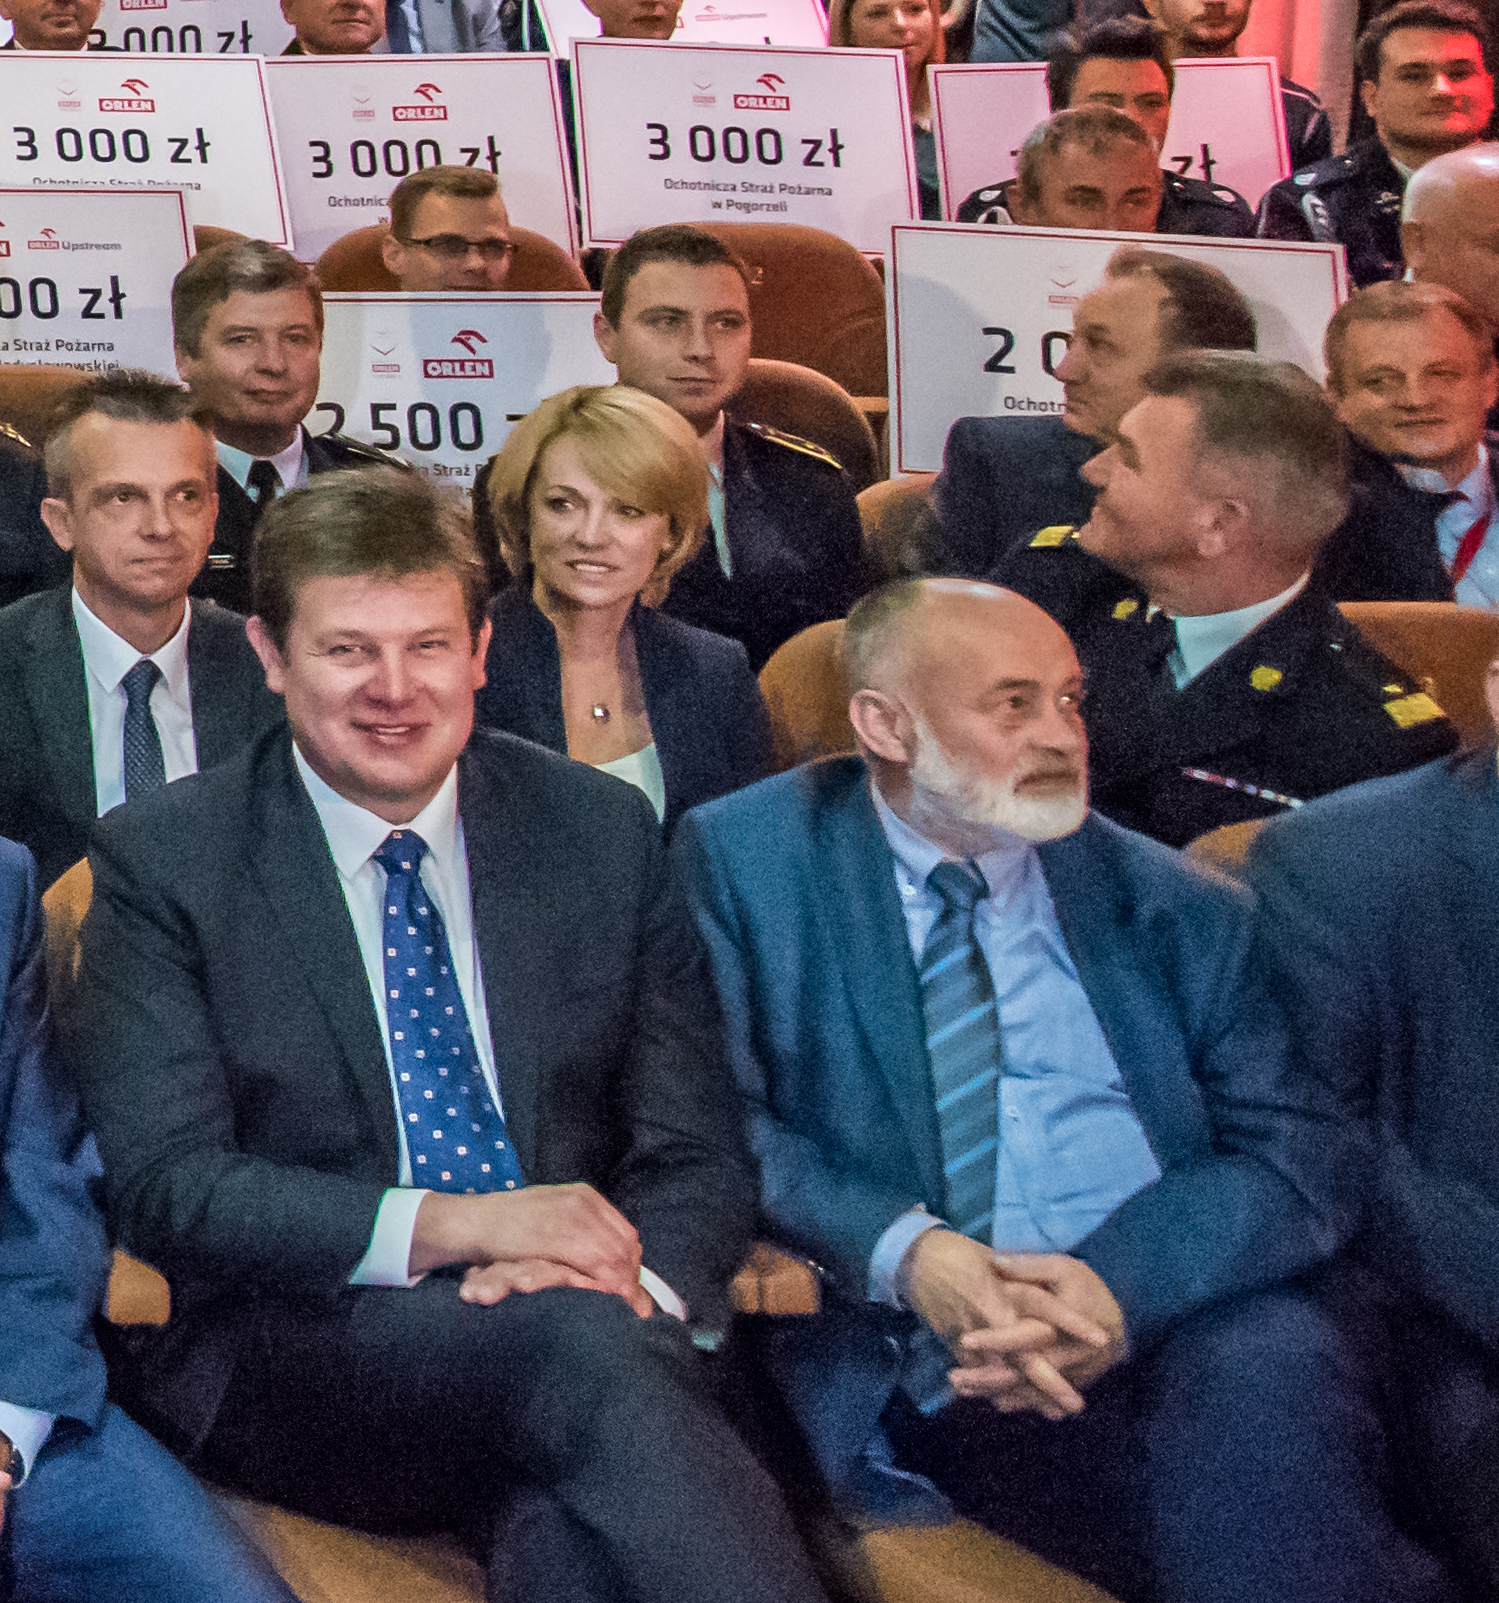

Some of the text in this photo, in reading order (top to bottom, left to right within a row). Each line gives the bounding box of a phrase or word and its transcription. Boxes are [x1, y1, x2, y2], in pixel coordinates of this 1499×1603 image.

[99, 100, 153, 112] ORLEN
[735, 95, 789, 110] ORLEN
[14, 127, 210, 163] 3 000 zł
[647, 123, 844, 167] 3 000 zł
[664, 178, 832, 196] Ochotnicza Straż Pożarna
[711, 199, 788, 214] w Pogorzeli
[62, 239, 121, 251] Upstream
[79, 276, 126, 319] zł
[424, 360, 493, 377] ORLEN
[370, 401, 484, 451] 500
